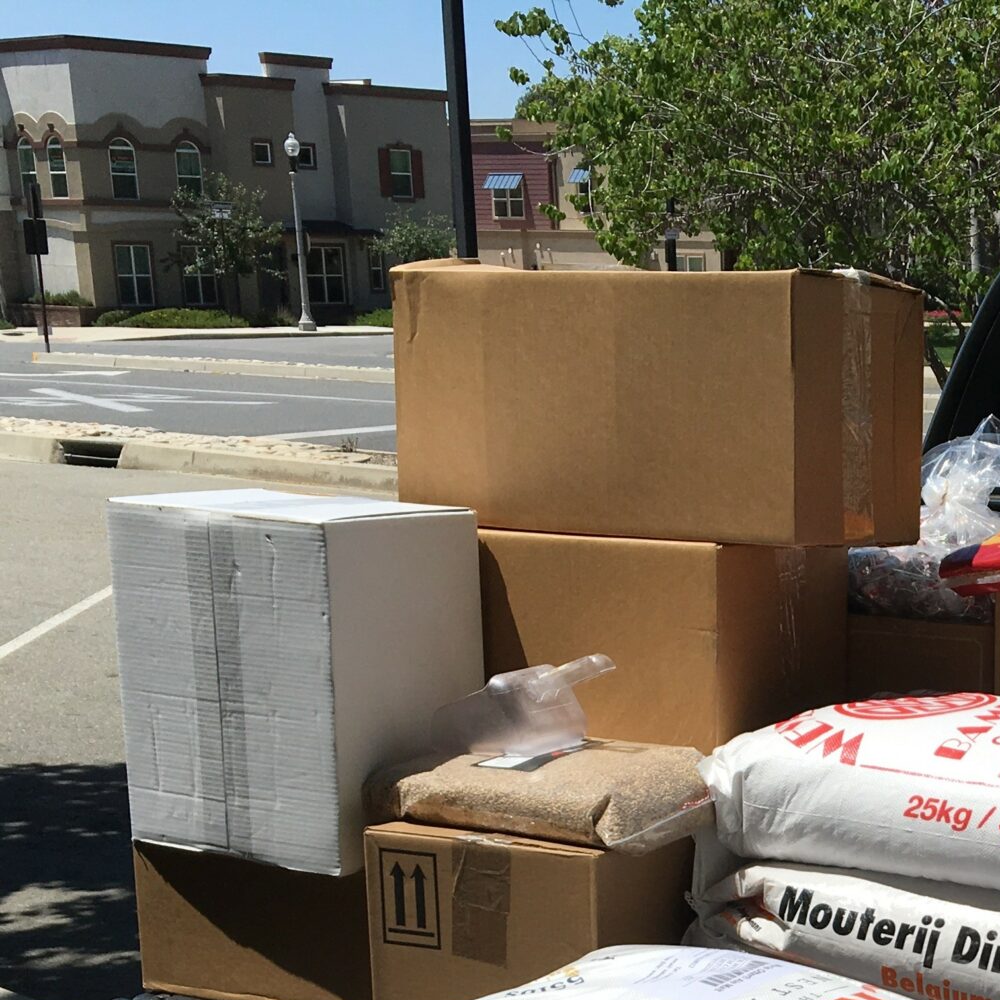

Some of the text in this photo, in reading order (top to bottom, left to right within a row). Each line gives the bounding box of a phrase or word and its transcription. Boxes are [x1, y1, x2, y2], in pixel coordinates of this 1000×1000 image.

[903, 794, 973, 832] 25kg
[976, 806, 997, 829] /
[778, 884, 946, 969] Mouterij
